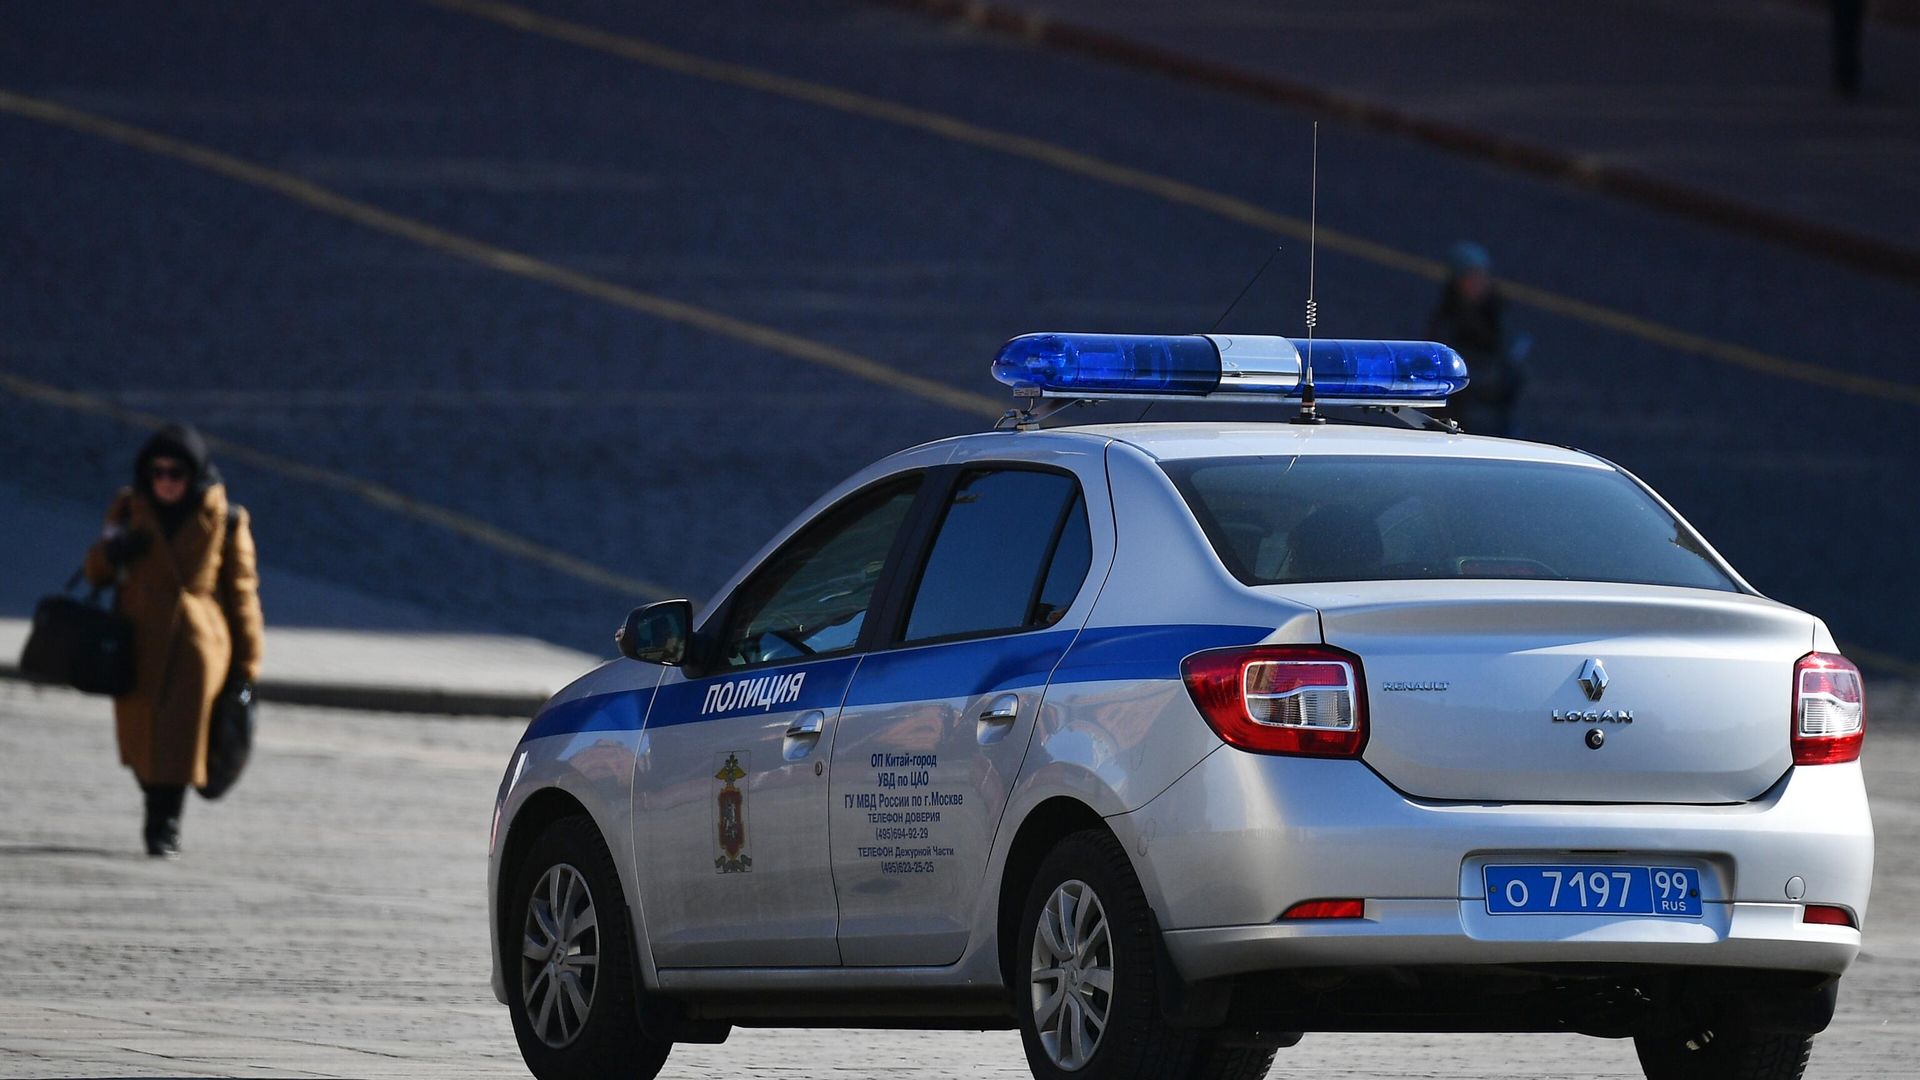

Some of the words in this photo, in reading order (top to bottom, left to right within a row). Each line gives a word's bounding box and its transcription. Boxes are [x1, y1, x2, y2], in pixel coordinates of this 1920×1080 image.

[701, 672, 806, 715] ПОЛИЦИЯ
[1383, 681, 1450, 692] RENAULT
[1552, 709, 1634, 724] LOGAN
[871, 753, 884, 768] ОП
[885, 753, 937, 769] Китай-город
[878, 772, 896, 789] УВД
[897, 775, 909, 787] по
[910, 771, 929, 788] ЦАО
[844, 794, 855, 809] ГУ
[856, 793, 877, 810] МВД
[879, 793, 910, 808] России
[911, 795, 922, 807] по
[868, 813, 904, 824] ТЕЛЕФОН
[905, 812, 941, 824] ДОВЕРИЯ
[858, 847, 894, 857] ТЕЛЕФОН
[895, 846, 932, 859] Дежурной
[933, 846, 954, 857] Части
[1541, 871, 1632, 908] 7197
[1654, 871, 1688, 900] 99
[1661, 900, 1687, 912] RUS
